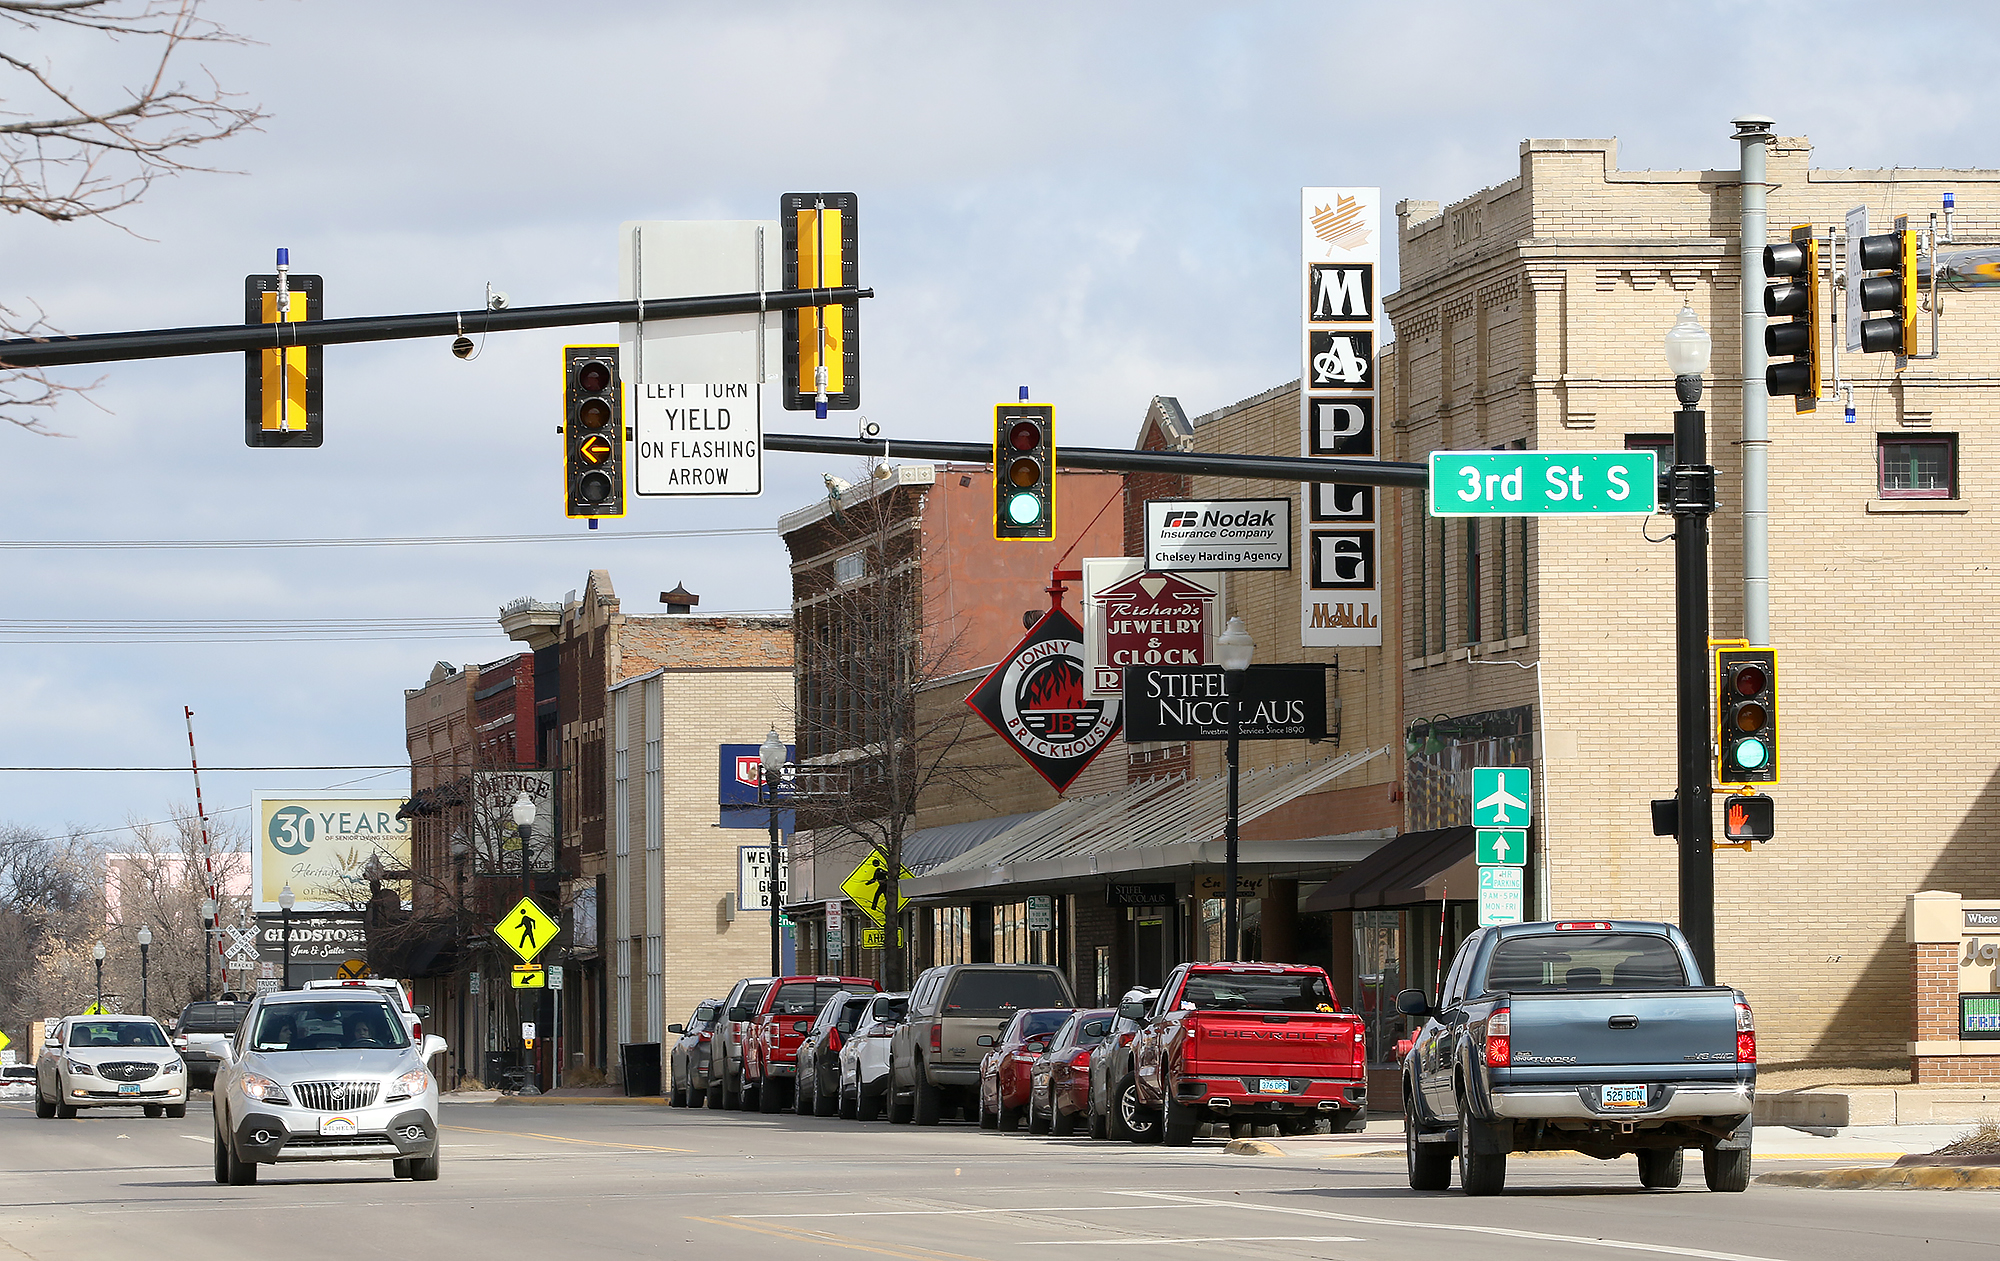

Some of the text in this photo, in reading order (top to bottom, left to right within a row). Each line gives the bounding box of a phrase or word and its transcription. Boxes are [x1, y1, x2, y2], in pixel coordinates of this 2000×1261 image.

[665, 408, 731, 431] YIELD
[641, 440, 756, 459] ON FLASHING
[668, 468, 729, 485] ARROW
[1457, 465, 1630, 502] 3rd St S
[1202, 510, 1276, 527] Nodak
[1160, 529, 1274, 539] Insurance Company
[1155, 551, 1282, 563] Chelsey Harding Agency
[1309, 602, 1378, 628] MALL
[1108, 619, 1202, 635] JEWELRY
[1148, 637, 1161, 648] &
[1016, 641, 1070, 672] JONNY
[1113, 649, 1197, 665] CLOCK
[1147, 671, 1229, 698] STIFEL
[1045, 714, 1075, 733] JB
[1008, 716, 1113, 757] BRICKHOUSE
[276, 812, 408, 848] 30 YEARS
[1482, 871, 1492, 887] 2
[1494, 879, 1520, 887] PARKING
[1115, 885, 1143, 894] STIFEL
[1119, 894, 1166, 903] NICOLAUS
[1967, 914, 1998, 924] Where
[290, 945, 309, 957] Inn
[1208, 1029, 1343, 1041] CHEVROLET
[1606, 1091, 1643, 1101] 525 BCN
